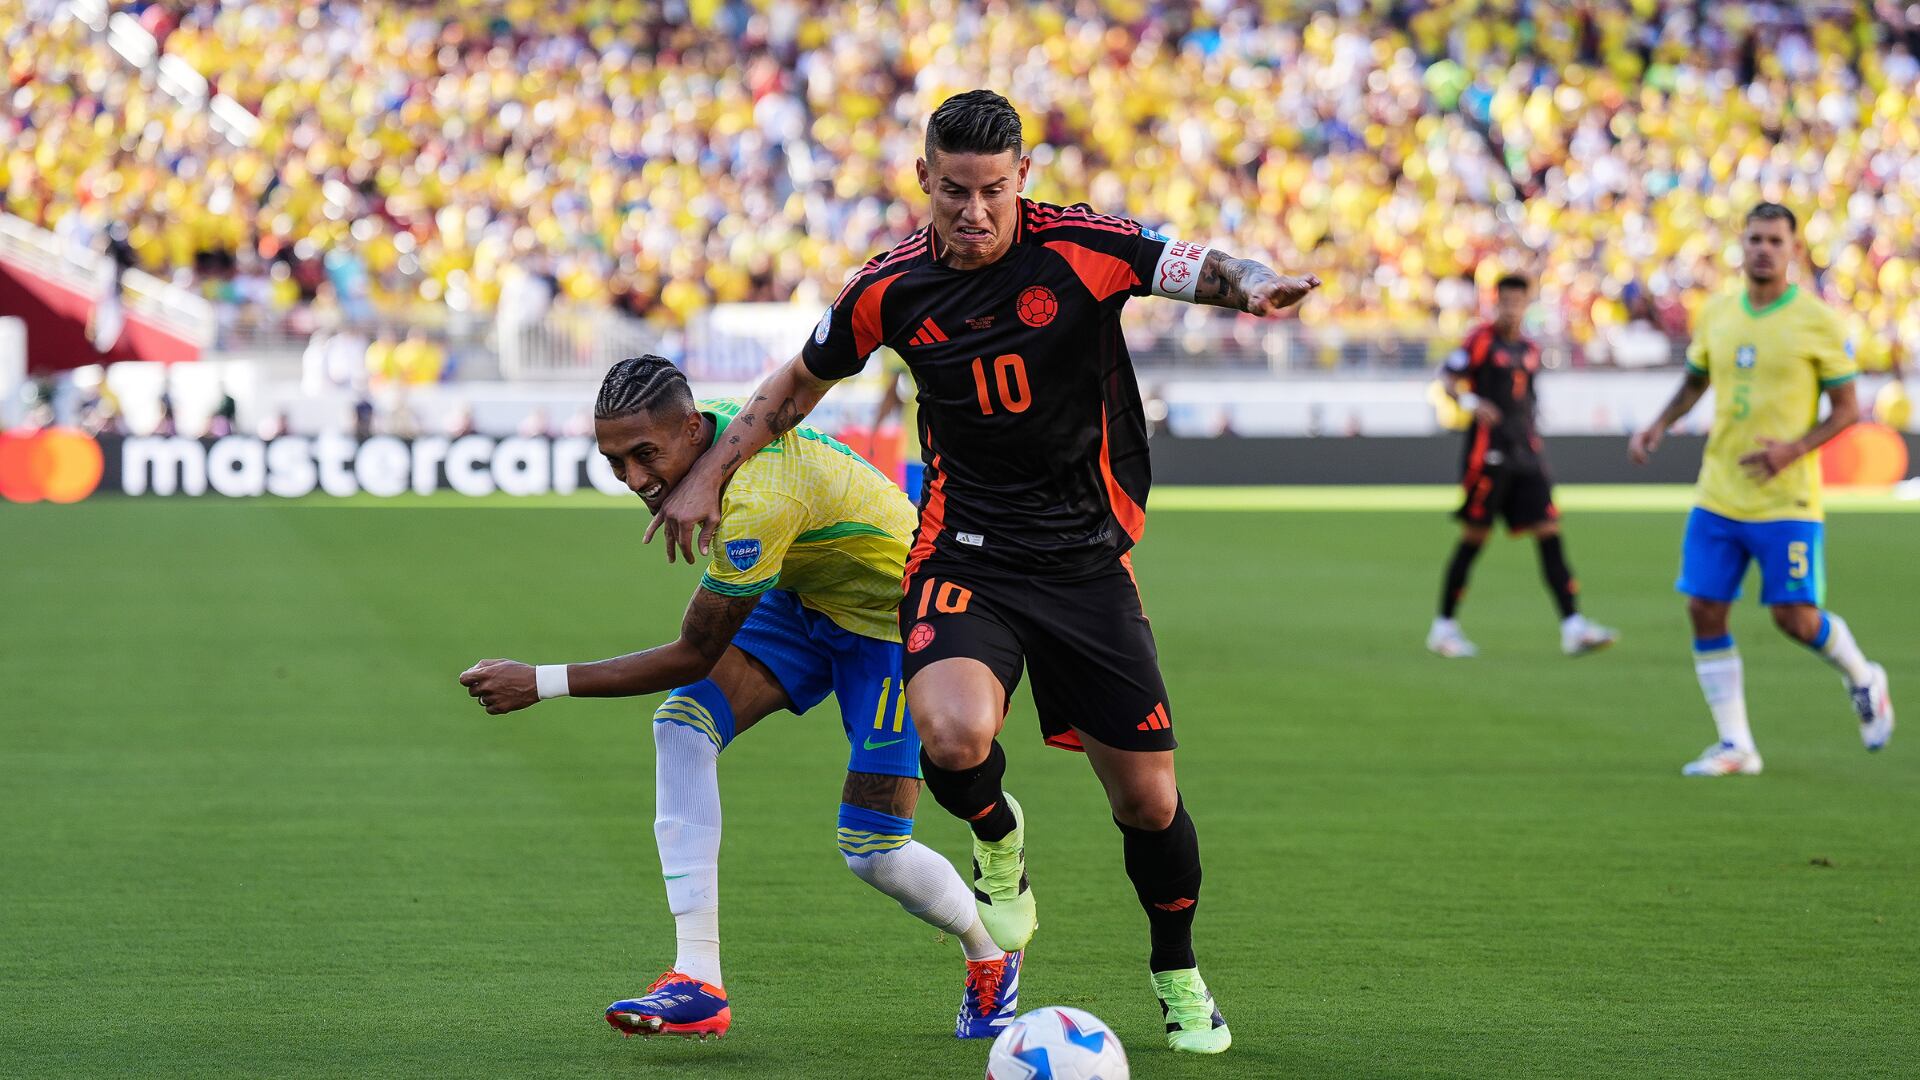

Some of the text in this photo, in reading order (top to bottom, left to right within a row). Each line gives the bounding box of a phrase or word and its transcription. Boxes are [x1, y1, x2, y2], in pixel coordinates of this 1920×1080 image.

[972, 354, 1032, 415] 10
[1732, 383, 1752, 421] 5
[730, 546, 758, 556] VIBRA
[1788, 541, 1809, 578] 5
[917, 577, 973, 620] 10
[873, 677, 907, 733] 11
